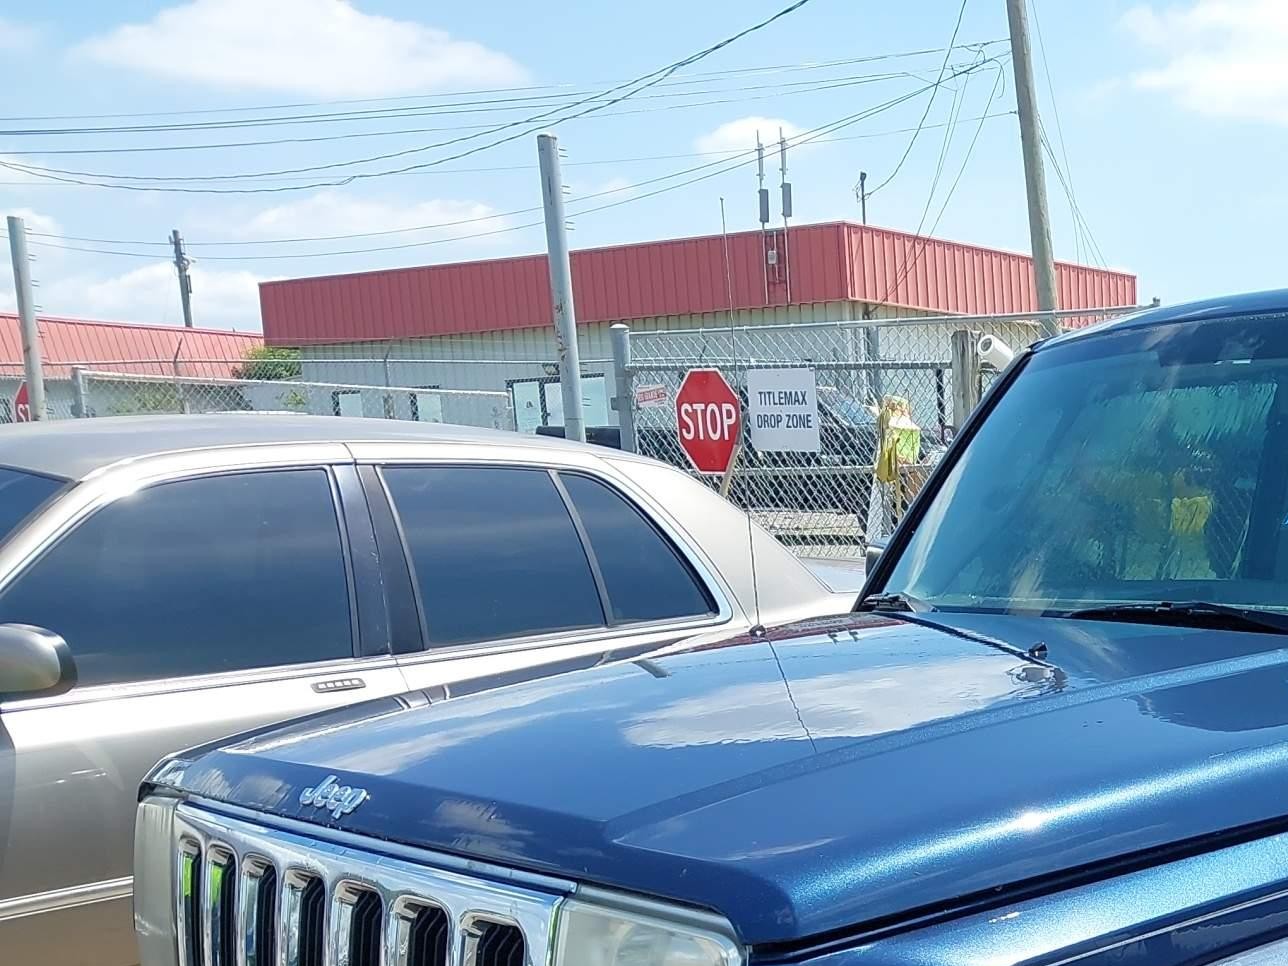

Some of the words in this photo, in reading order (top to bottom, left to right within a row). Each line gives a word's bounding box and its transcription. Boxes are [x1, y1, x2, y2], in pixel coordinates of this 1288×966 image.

[758, 391, 807, 406] TITLEMAX
[680, 403, 736, 441] STOP
[757, 414, 782, 429] DROP
[786, 414, 812, 429] ZONE
[299, 774, 368, 820] Jeep
